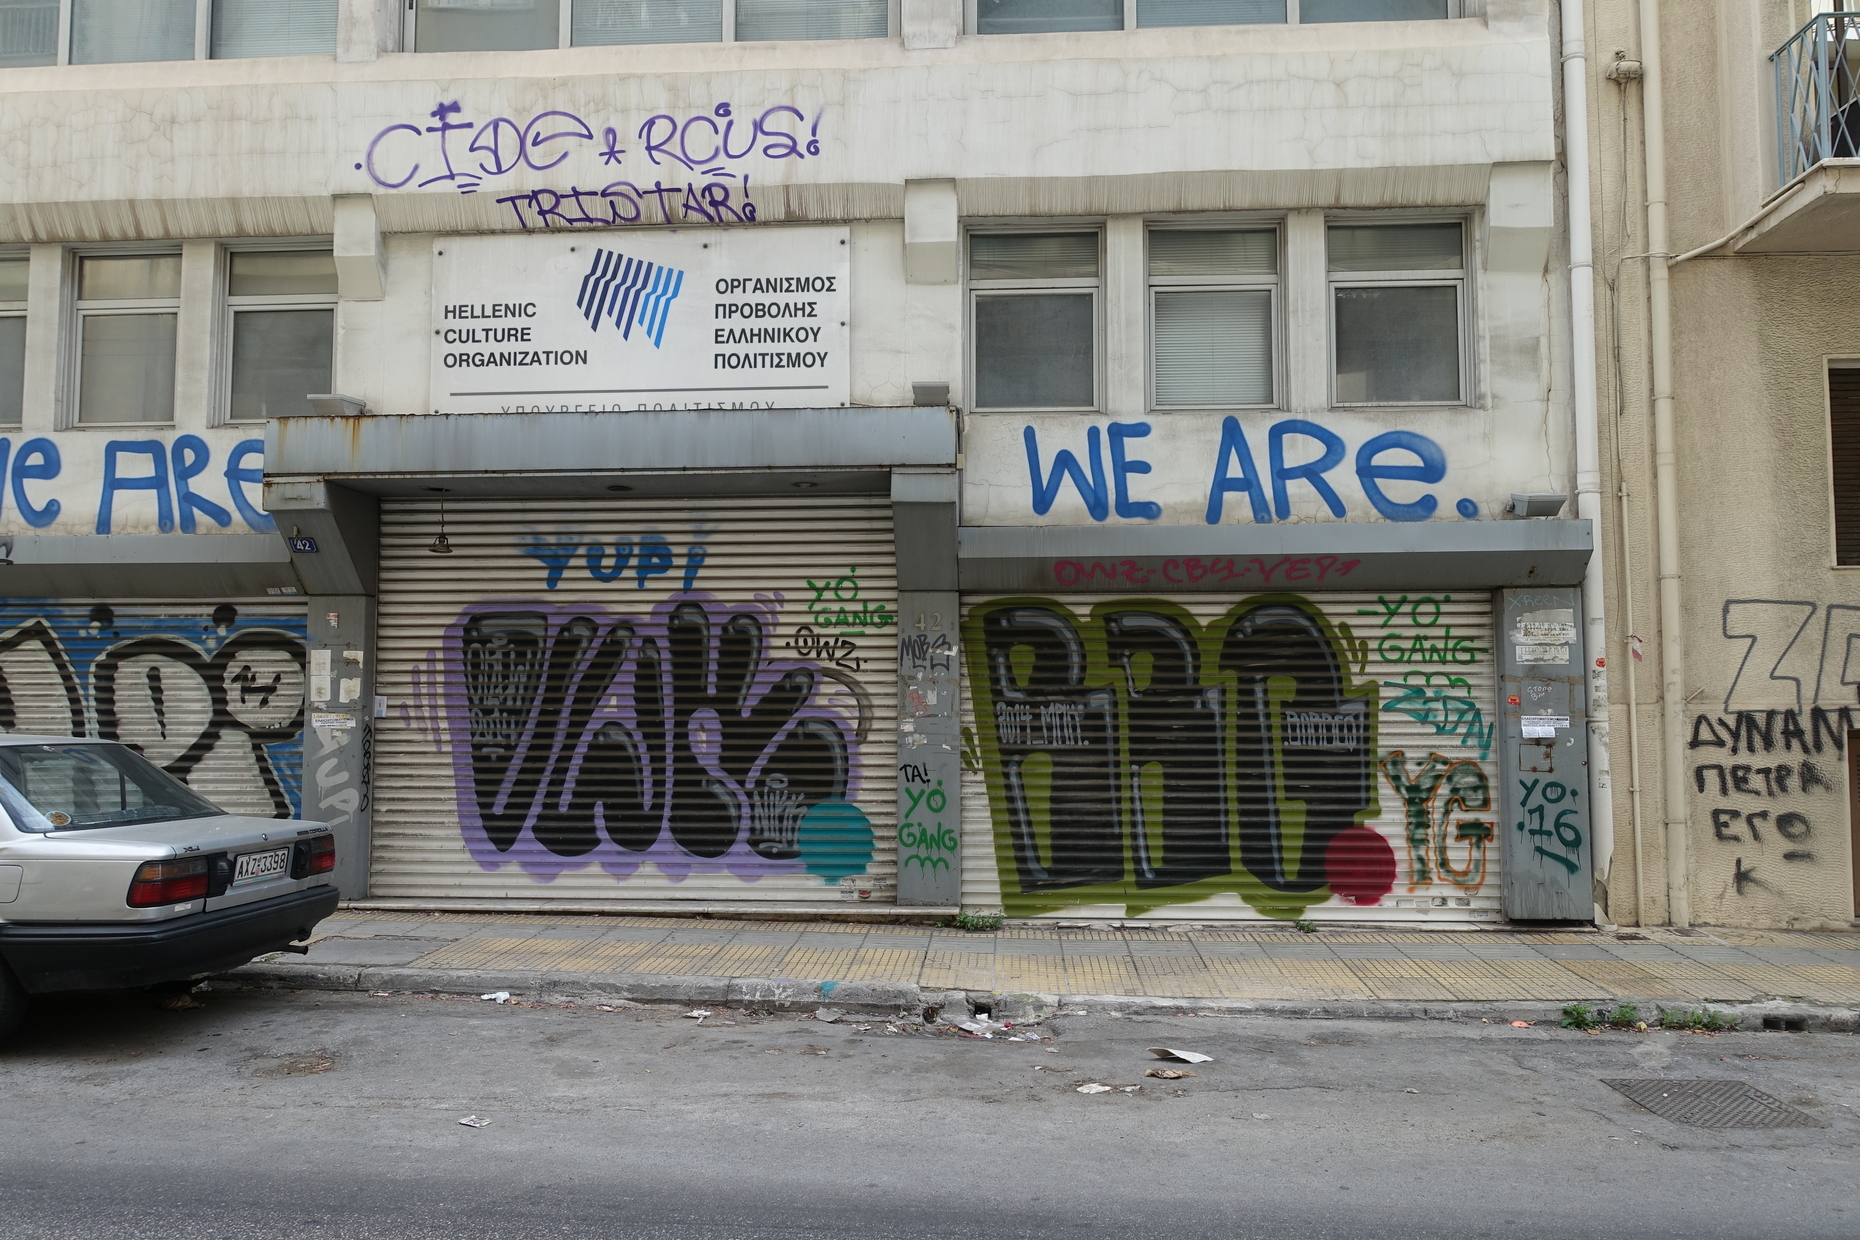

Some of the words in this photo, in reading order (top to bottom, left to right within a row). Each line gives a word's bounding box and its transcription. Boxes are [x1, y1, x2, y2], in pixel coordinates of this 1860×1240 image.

[715, 276, 837, 295] ΟΡΓΑΝΙΣΜΟΣ
[444, 303, 537, 320] HELLENIC
[714, 301, 818, 320] ΠΡΟΒΟΛΗΣ
[444, 328, 532, 345] CULTURE
[714, 326, 822, 345] ΕΛΛΗΝΙΚΟΥ
[443, 350, 588, 369] ORGANIZATION
[714, 351, 829, 370] ΠΟΛΙΤΙΣΜΟΥ
[1023, 422, 1162, 522] WE
[296, 540, 312, 550] 42
[914, 612, 942, 631] 42
[899, 822, 957, 852] GANG
